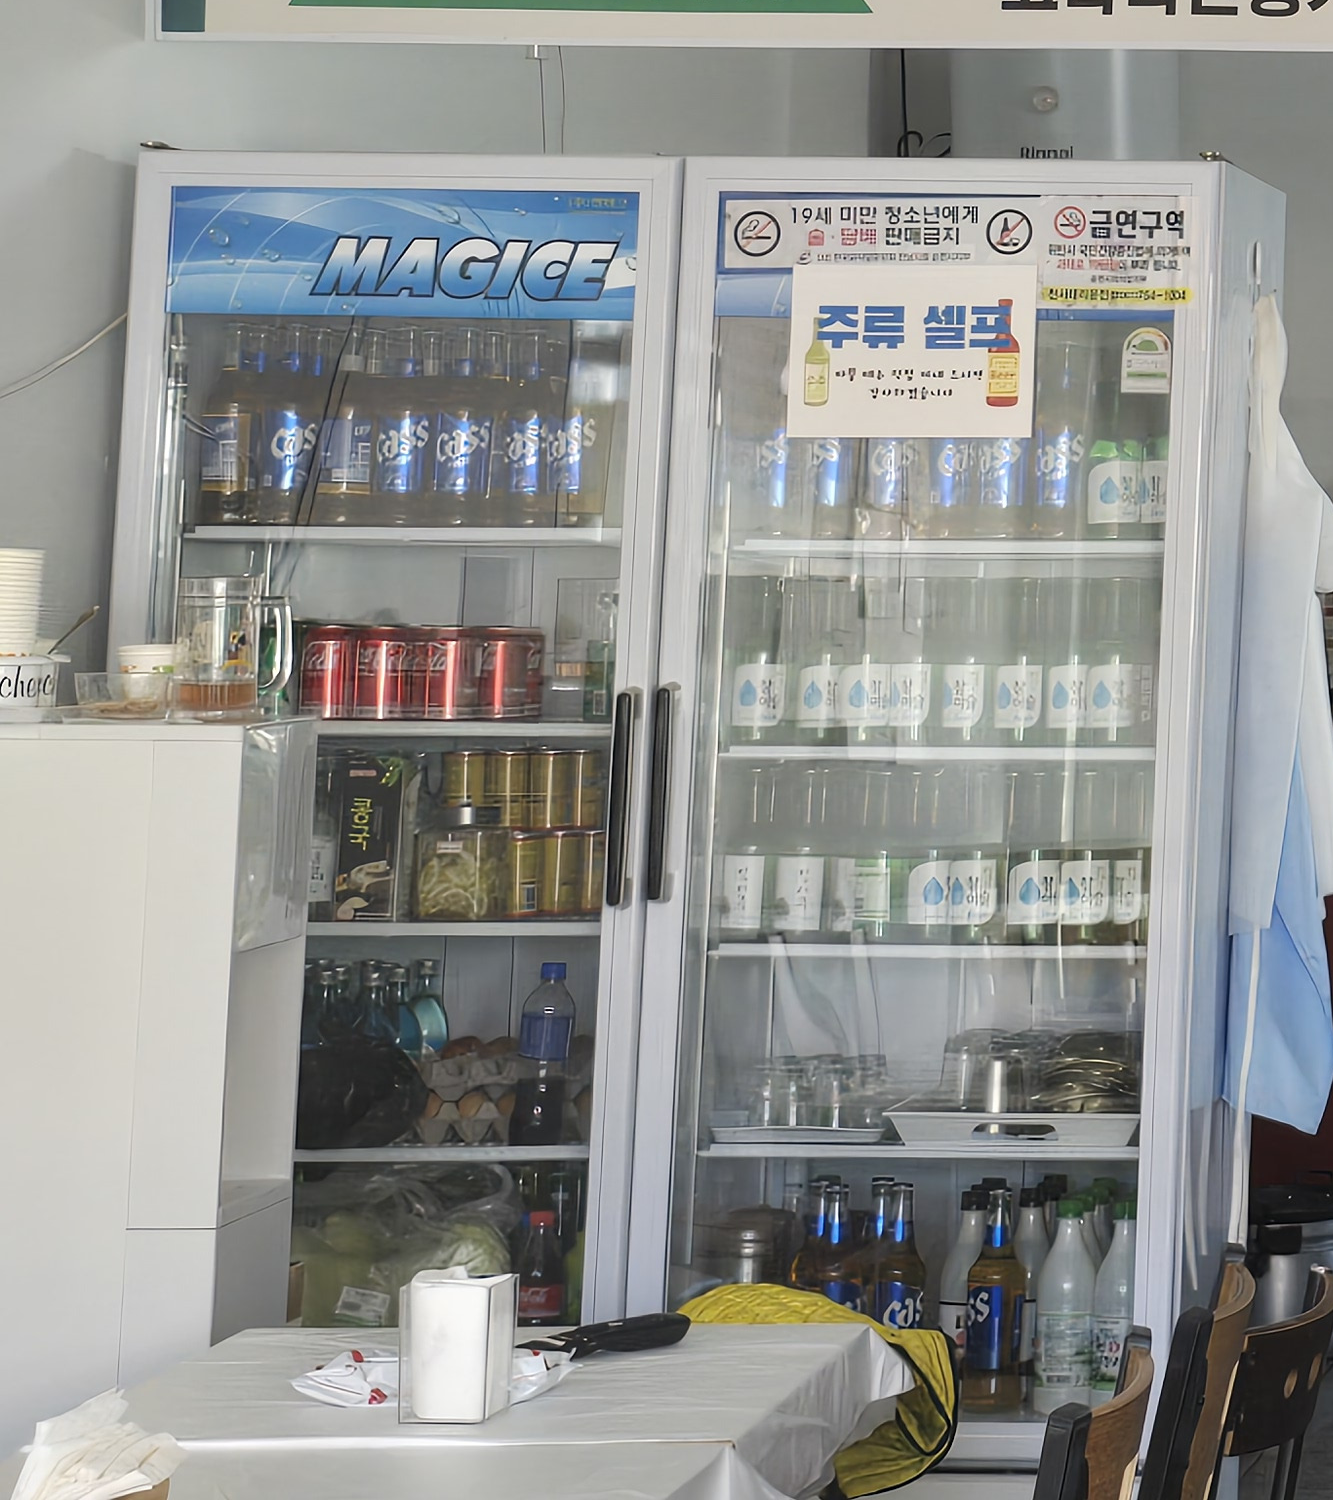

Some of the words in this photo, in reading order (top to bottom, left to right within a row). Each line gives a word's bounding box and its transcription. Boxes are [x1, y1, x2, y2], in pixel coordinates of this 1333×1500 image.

[884, 205, 980, 225] 청소년에게
[1089, 209, 1186, 240] 금연구역
[308, 236, 622, 302] MAGICE
[816, 305, 905, 349] 주류
[923, 305, 1011, 350] 셀프
